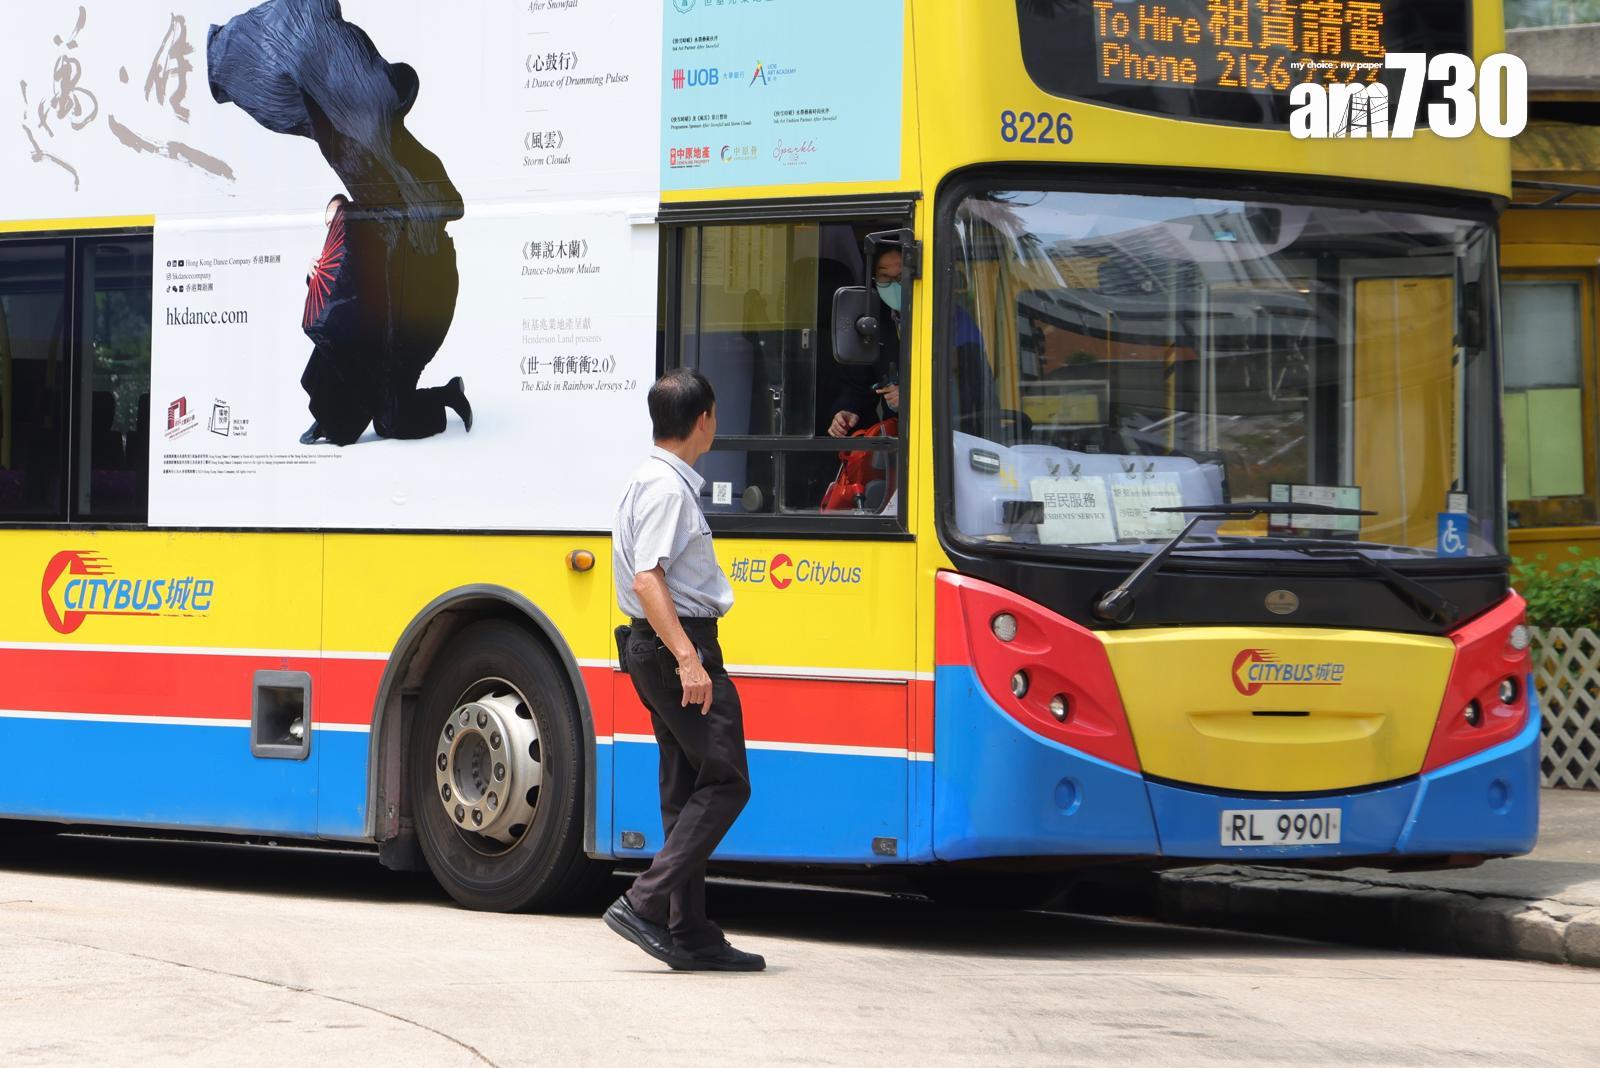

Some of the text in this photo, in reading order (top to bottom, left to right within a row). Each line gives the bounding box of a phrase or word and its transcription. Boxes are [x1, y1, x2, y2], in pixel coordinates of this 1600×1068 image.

[1093, 1, 1201, 44] To Hire
[525, 51, 579, 73] 《心鼓行》
[1102, 42, 1198, 84] Phone
[1217, 52, 1292, 91] 2136
[523, 72, 630, 90] A Dance of Drumming Pulses
[687, 68, 720, 88] UOB
[1001, 110, 1073, 144] 8226
[524, 130, 564, 151] 《風雲》
[523, 153, 571, 167] Storm Clouds
[185, 259, 199, 268] Hong
[199, 258, 213, 268] Kong
[213, 257, 228, 266] Dance
[521, 263, 601, 277] Dance-to-know Mulan
[166, 307, 248, 325] hkdance.com
[522, 333, 603, 346] Henderson Land presents
[521, 377, 638, 393] The Kids in Rainbow Jerseys 2.0
[1044, 491, 1097, 509] 居民服務
[730, 557, 767, 583] 城巴
[796, 559, 862, 586] Citybus
[64, 579, 165, 611] CITYBUS
[165, 576, 215, 611] 城巴
[1248, 663, 1315, 682] CITYBUS
[1315, 662, 1345, 682] 城巴
[1232, 812, 1331, 841] RL 9901
